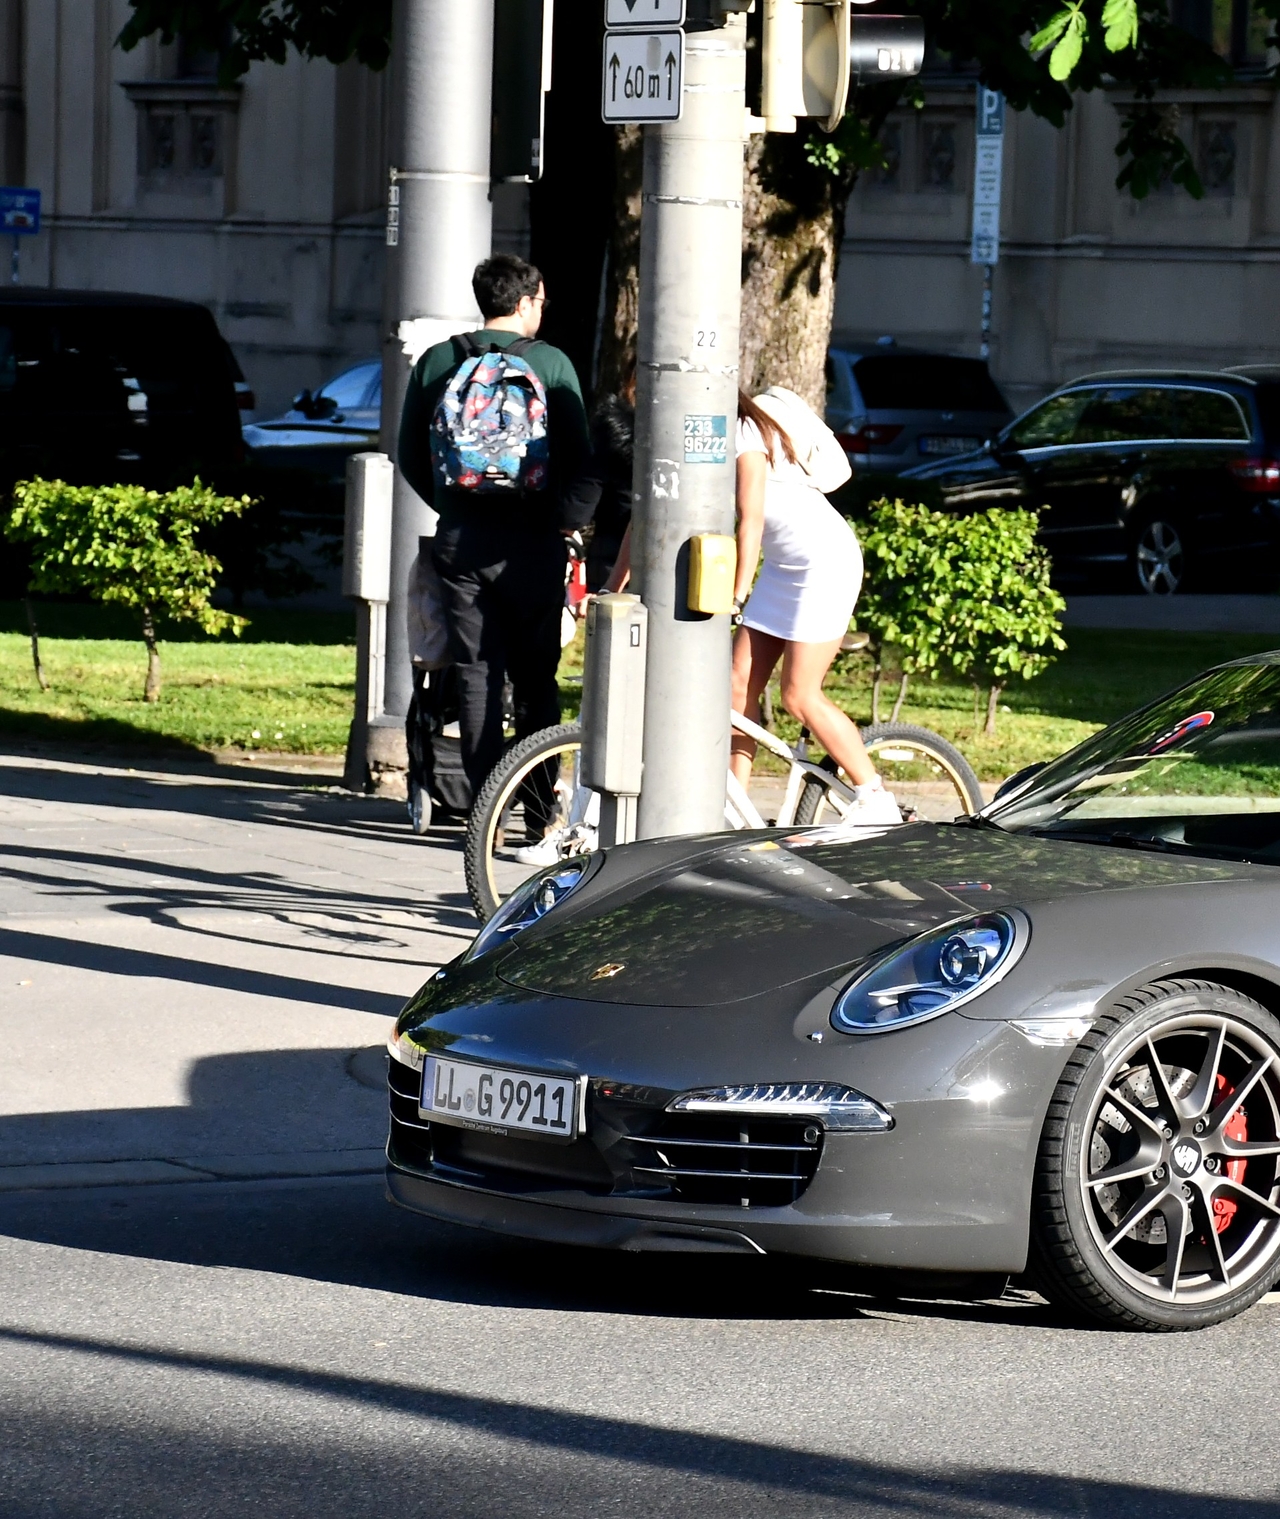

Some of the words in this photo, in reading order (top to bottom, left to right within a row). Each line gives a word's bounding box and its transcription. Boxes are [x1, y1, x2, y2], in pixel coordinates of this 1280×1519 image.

[624, 65, 644, 99] 60
[648, 74, 660, 98] m
[982, 88, 999, 129] P
[684, 420, 713, 436] 233
[684, 437, 727, 453] 96222
[631, 625, 639, 646] 1
[434, 1064, 461, 1111] LL
[478, 1073, 494, 1117] G
[499, 1078, 567, 1129] 9911
